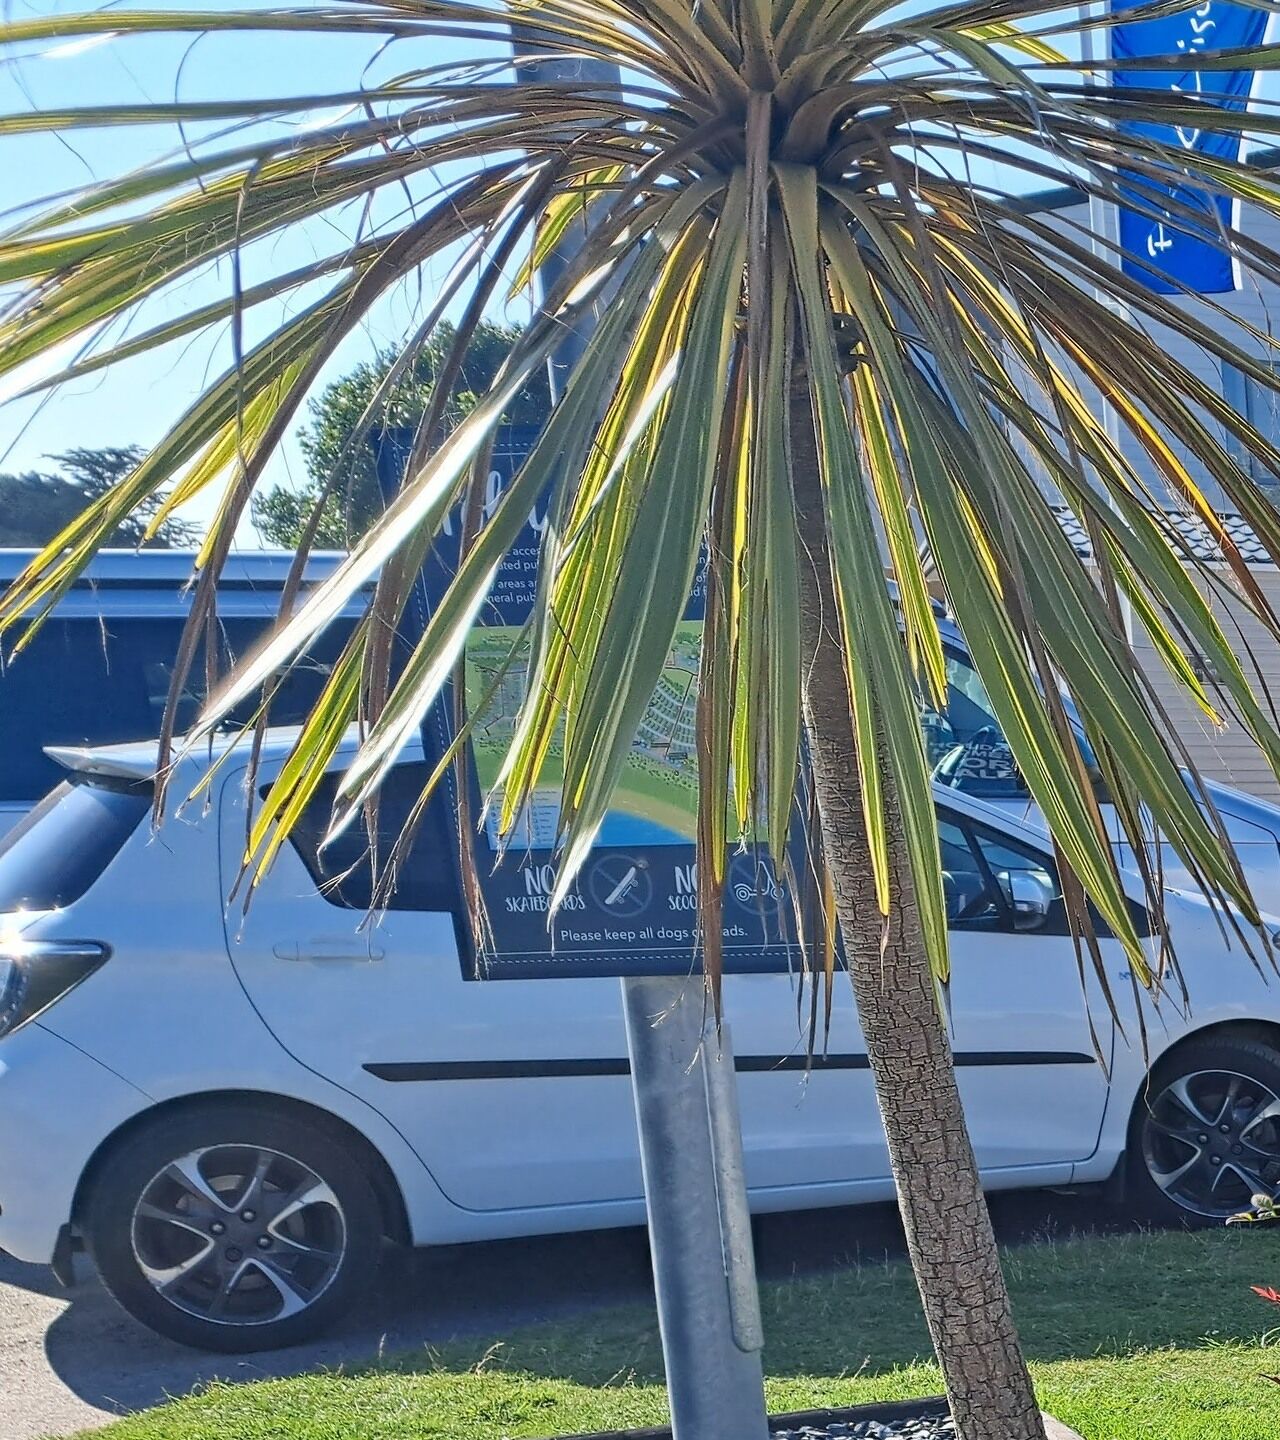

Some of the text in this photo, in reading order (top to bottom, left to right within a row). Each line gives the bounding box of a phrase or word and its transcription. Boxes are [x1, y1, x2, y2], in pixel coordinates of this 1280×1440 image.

[497, 580, 526, 589] areas
[487, 591, 537, 605] neral pub
[963, 757, 1011, 771] OR
[954, 767, 1016, 780] ALE
[524, 864, 557, 895] NO
[668, 894, 696, 911] SCOO
[560, 929, 602, 942] Please
[604, 928, 636, 944] keep
[639, 926, 654, 940] all
[657, 925, 689, 942] dogs
[722, 923, 749, 937] ads.
